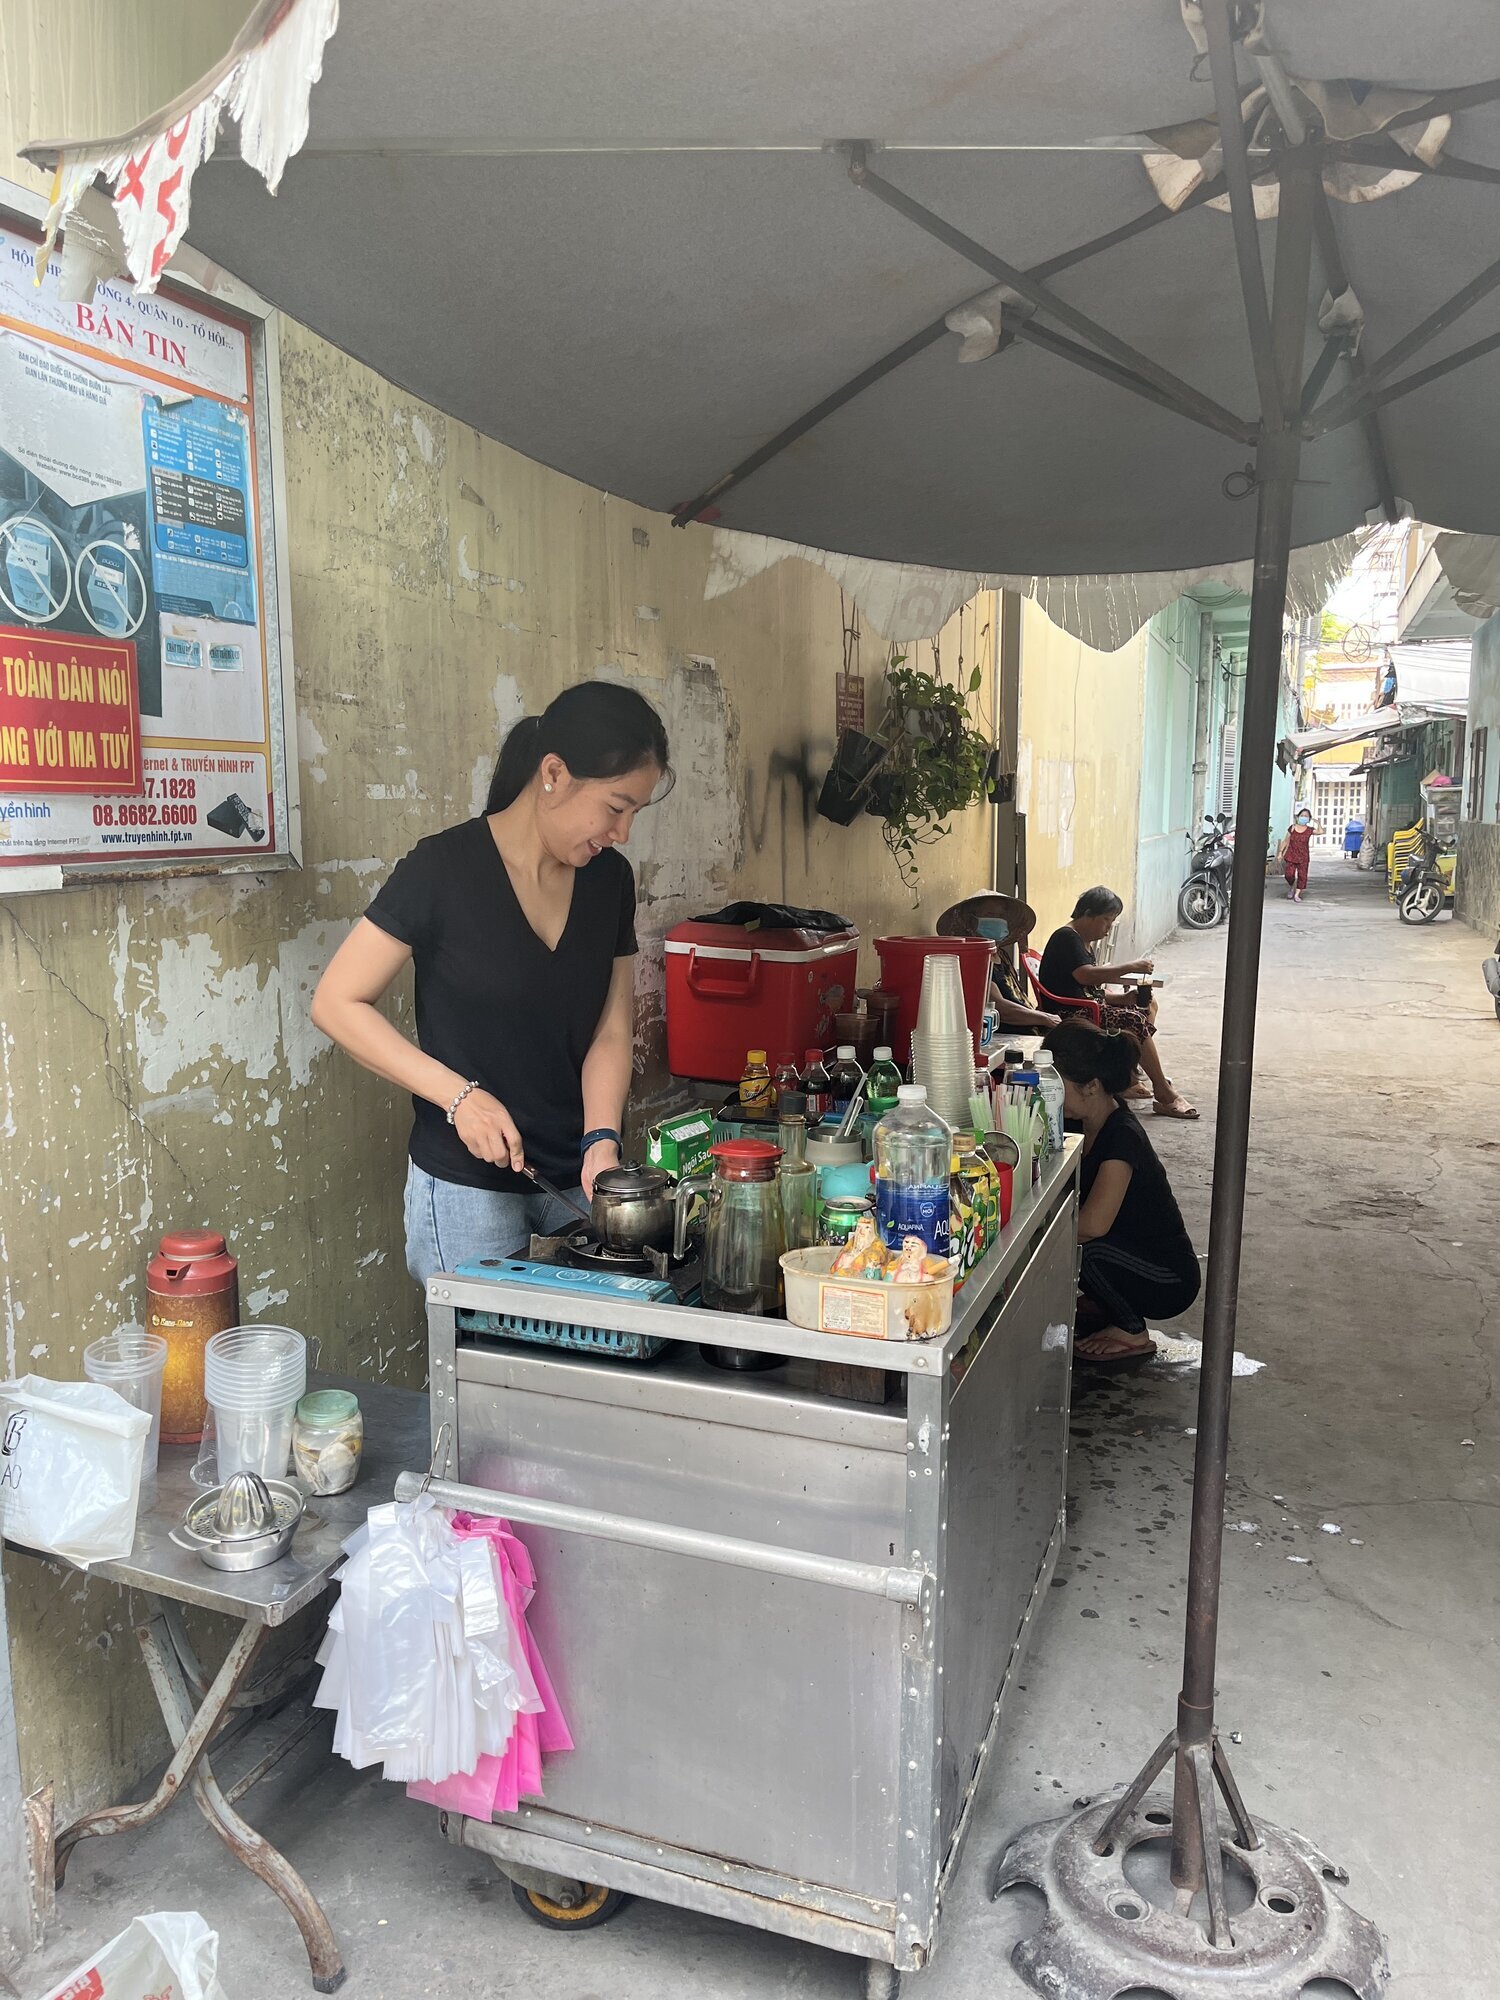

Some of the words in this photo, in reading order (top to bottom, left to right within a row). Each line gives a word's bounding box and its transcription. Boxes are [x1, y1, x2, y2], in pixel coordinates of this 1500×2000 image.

[11, 248, 34, 267] HỘI
[138, 300, 168, 321] QUẬN
[172, 316, 183, 328] 10
[192, 322, 206, 338] TỔ
[76, 304, 134, 348] BẢN
[142, 330, 186, 368] TIN
[2, 651, 52, 700] TOÀN
[57, 656, 94, 704] DÂN
[98, 661, 128, 706] NÓI
[0, 726, 30, 766] NG
[34, 721, 64, 768] VỚI
[68, 730, 97, 768] MA
[100, 726, 130, 770] TUÝ
[144, 758, 169, 772] ernet
[172, 760, 178, 772] &
[218, 757, 238, 774] HÌNH
[240, 760, 254, 774] FPT
[0, 800, 23, 822] yền
[24, 802, 50, 818] hình
[93, 804, 197, 826] 08.8682.6600
[102, 831, 192, 845] www.truyenhinh.fpt.vn
[682, 1154, 698, 1176] Ngôi
[898, 1223, 924, 1232] AQUAFINA
